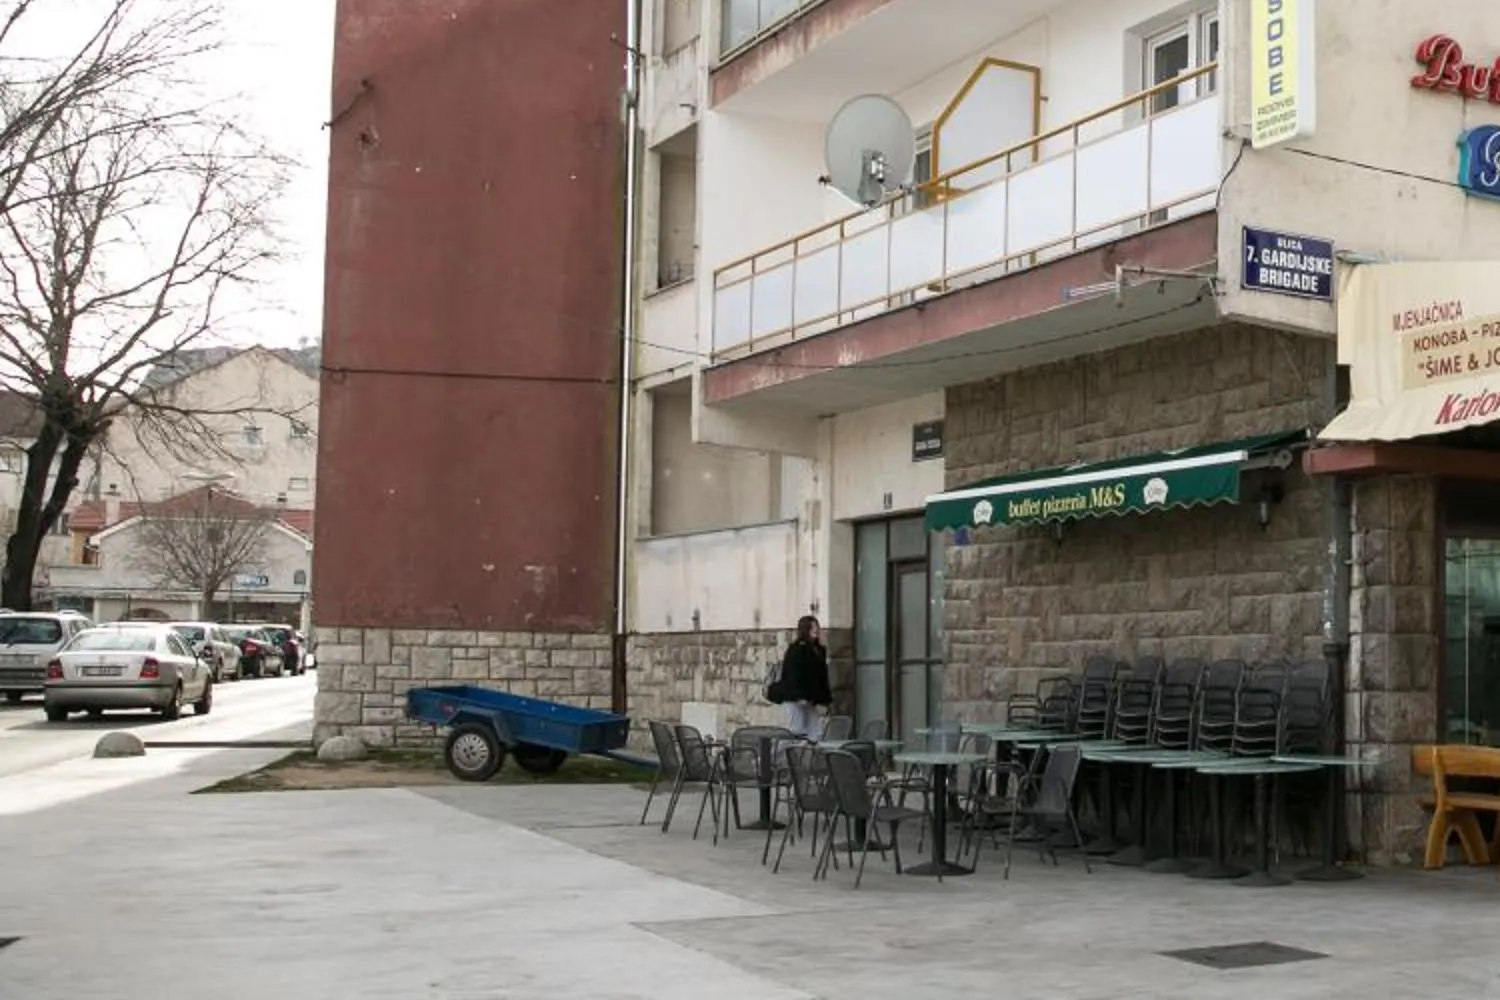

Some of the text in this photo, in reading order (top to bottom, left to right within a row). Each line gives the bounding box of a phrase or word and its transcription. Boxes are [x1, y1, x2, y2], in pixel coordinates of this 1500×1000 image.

[1246, 245, 1332, 275] 7. GARDIJSKE
[1259, 267, 1319, 293] BRIGADE
[1393, 300, 1463, 332] MJENJAČNICA
[1413, 329, 1469, 353] KONOBA
[1467, 353, 1479, 371] &
[1089, 483, 1125, 509] M&S
